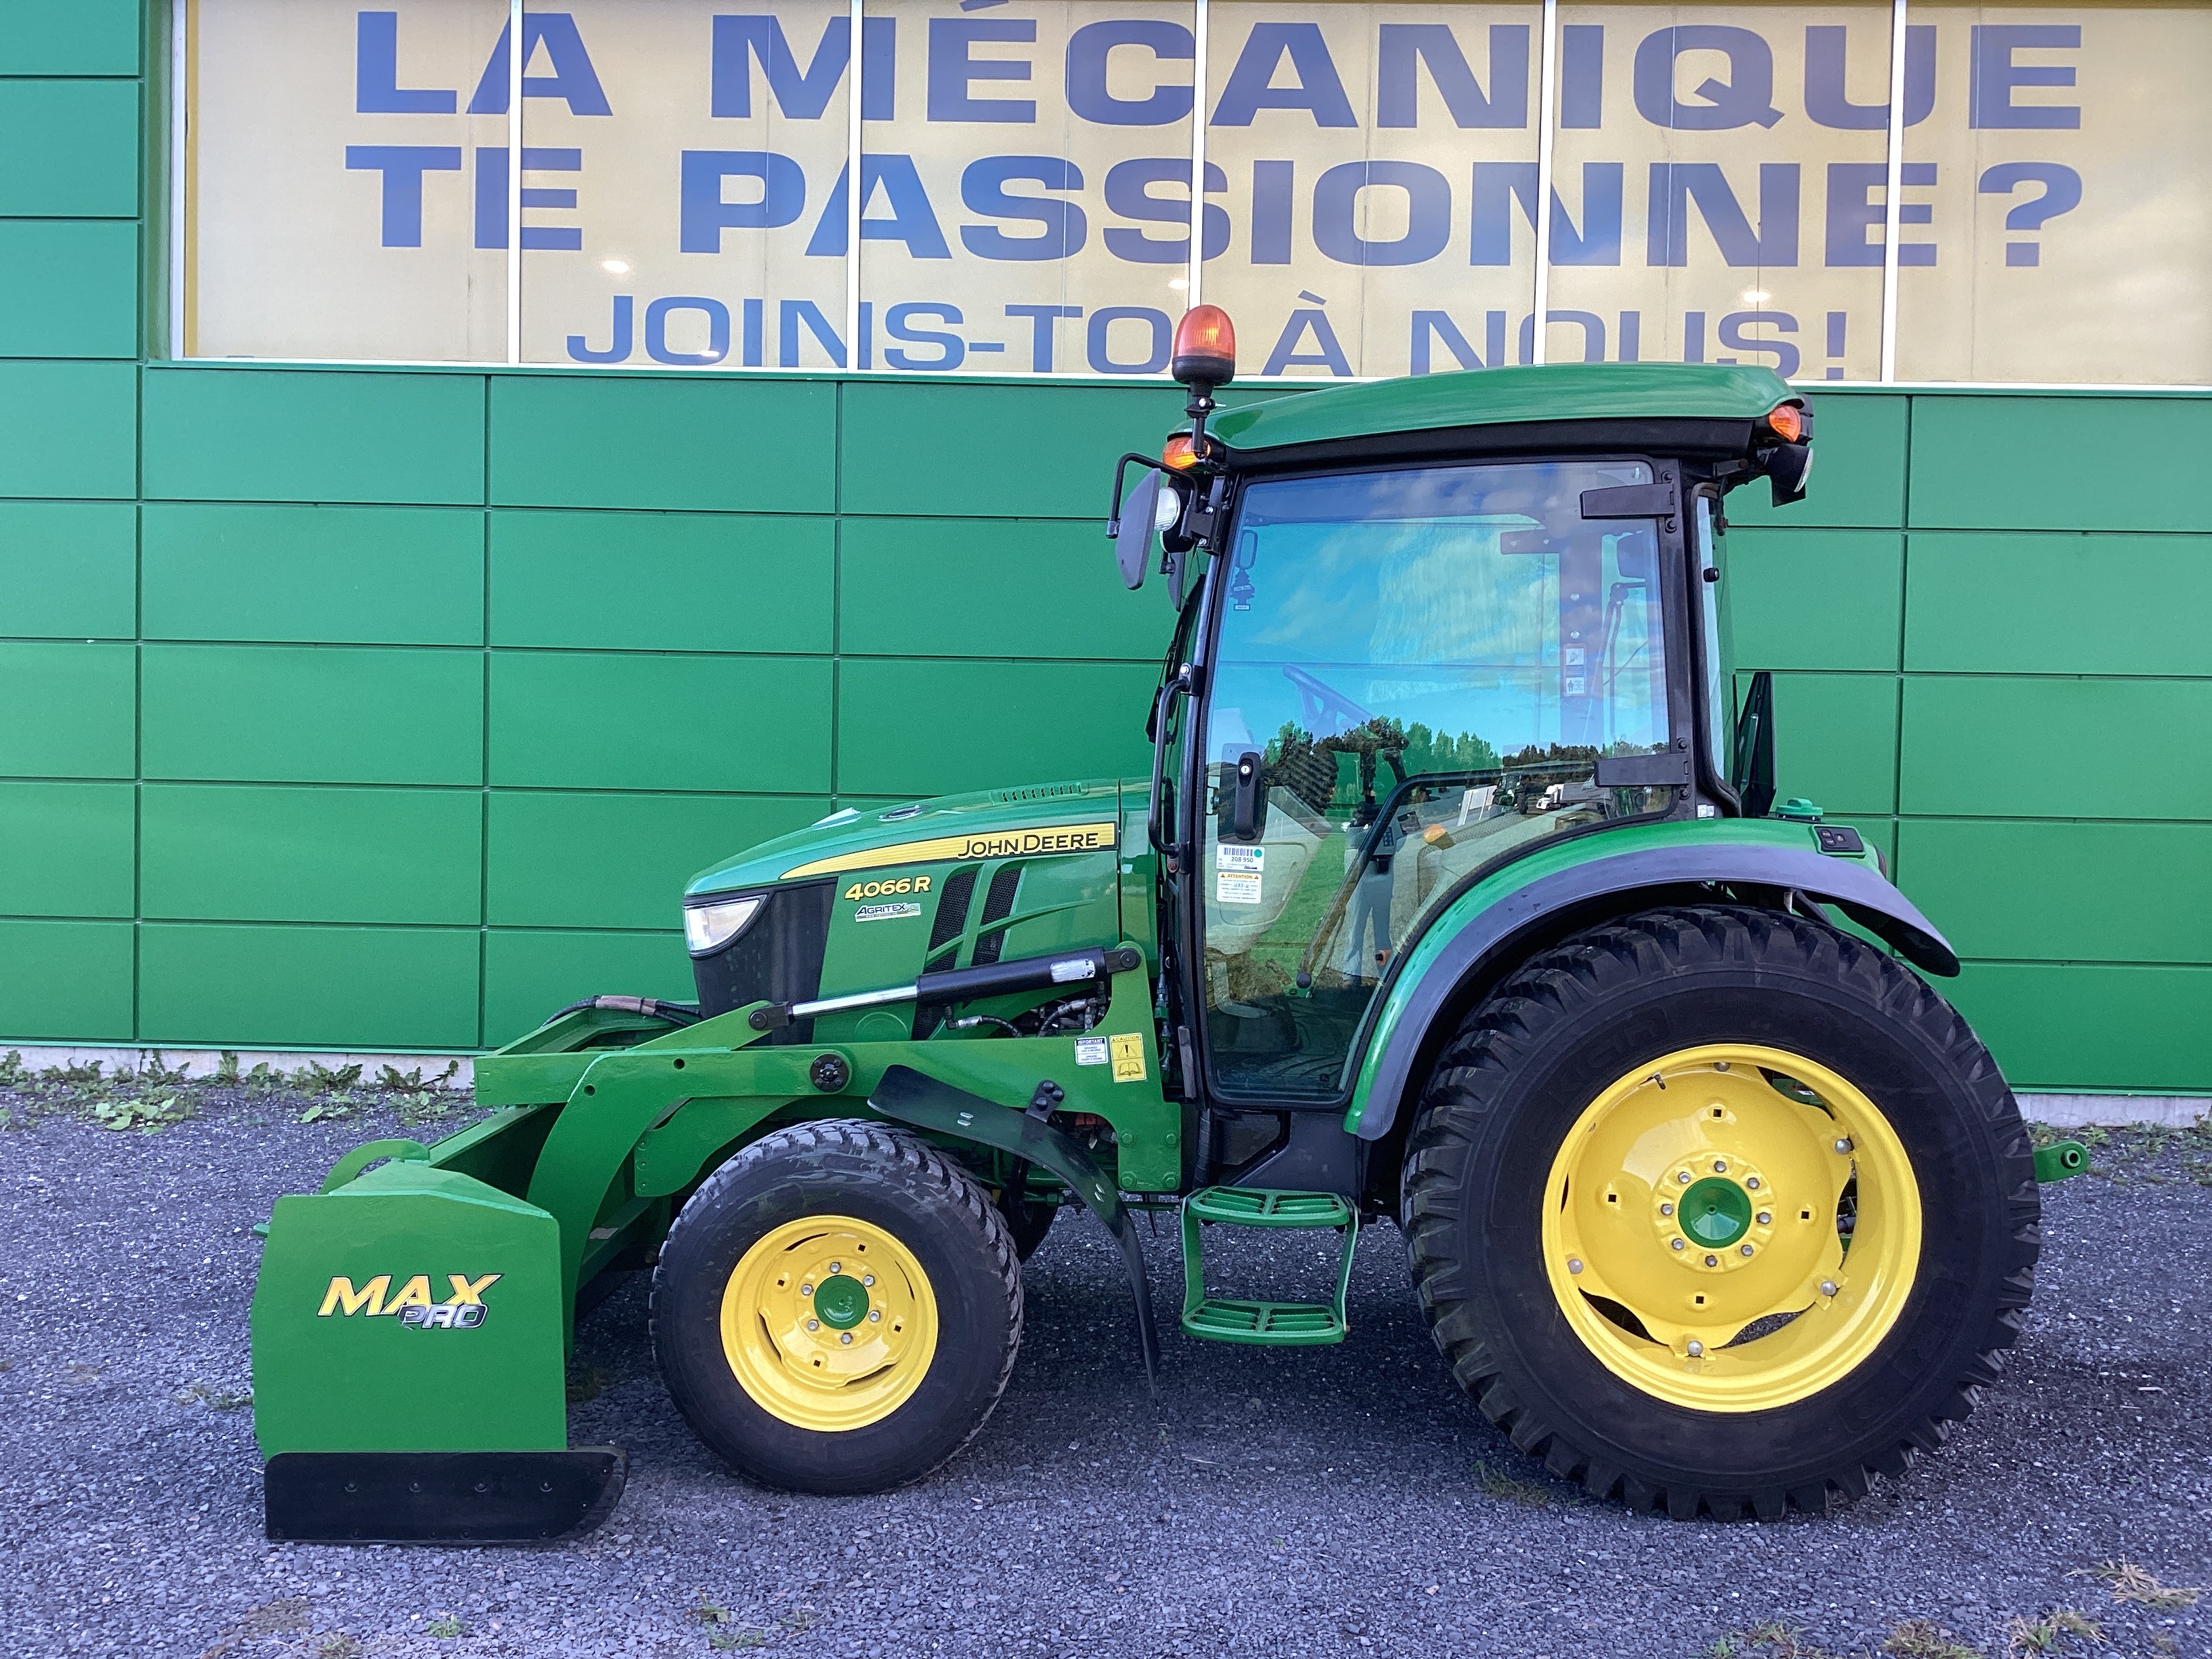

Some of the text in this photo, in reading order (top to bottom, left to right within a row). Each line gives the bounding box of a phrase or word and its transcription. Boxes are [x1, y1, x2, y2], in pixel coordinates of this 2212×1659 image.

[356, 0, 2082, 131] LA MÉCANIQUE
[346, 146, 582, 251] TE
[566, 295, 1174, 374] JOINS-TO
[1261, 289, 1354, 377] À
[958, 832, 1099, 857] JOHN DEERE
[857, 904, 905, 915] AGRITEX
[317, 1274, 503, 1317] MAX
[396, 1304, 488, 1330] PRO
